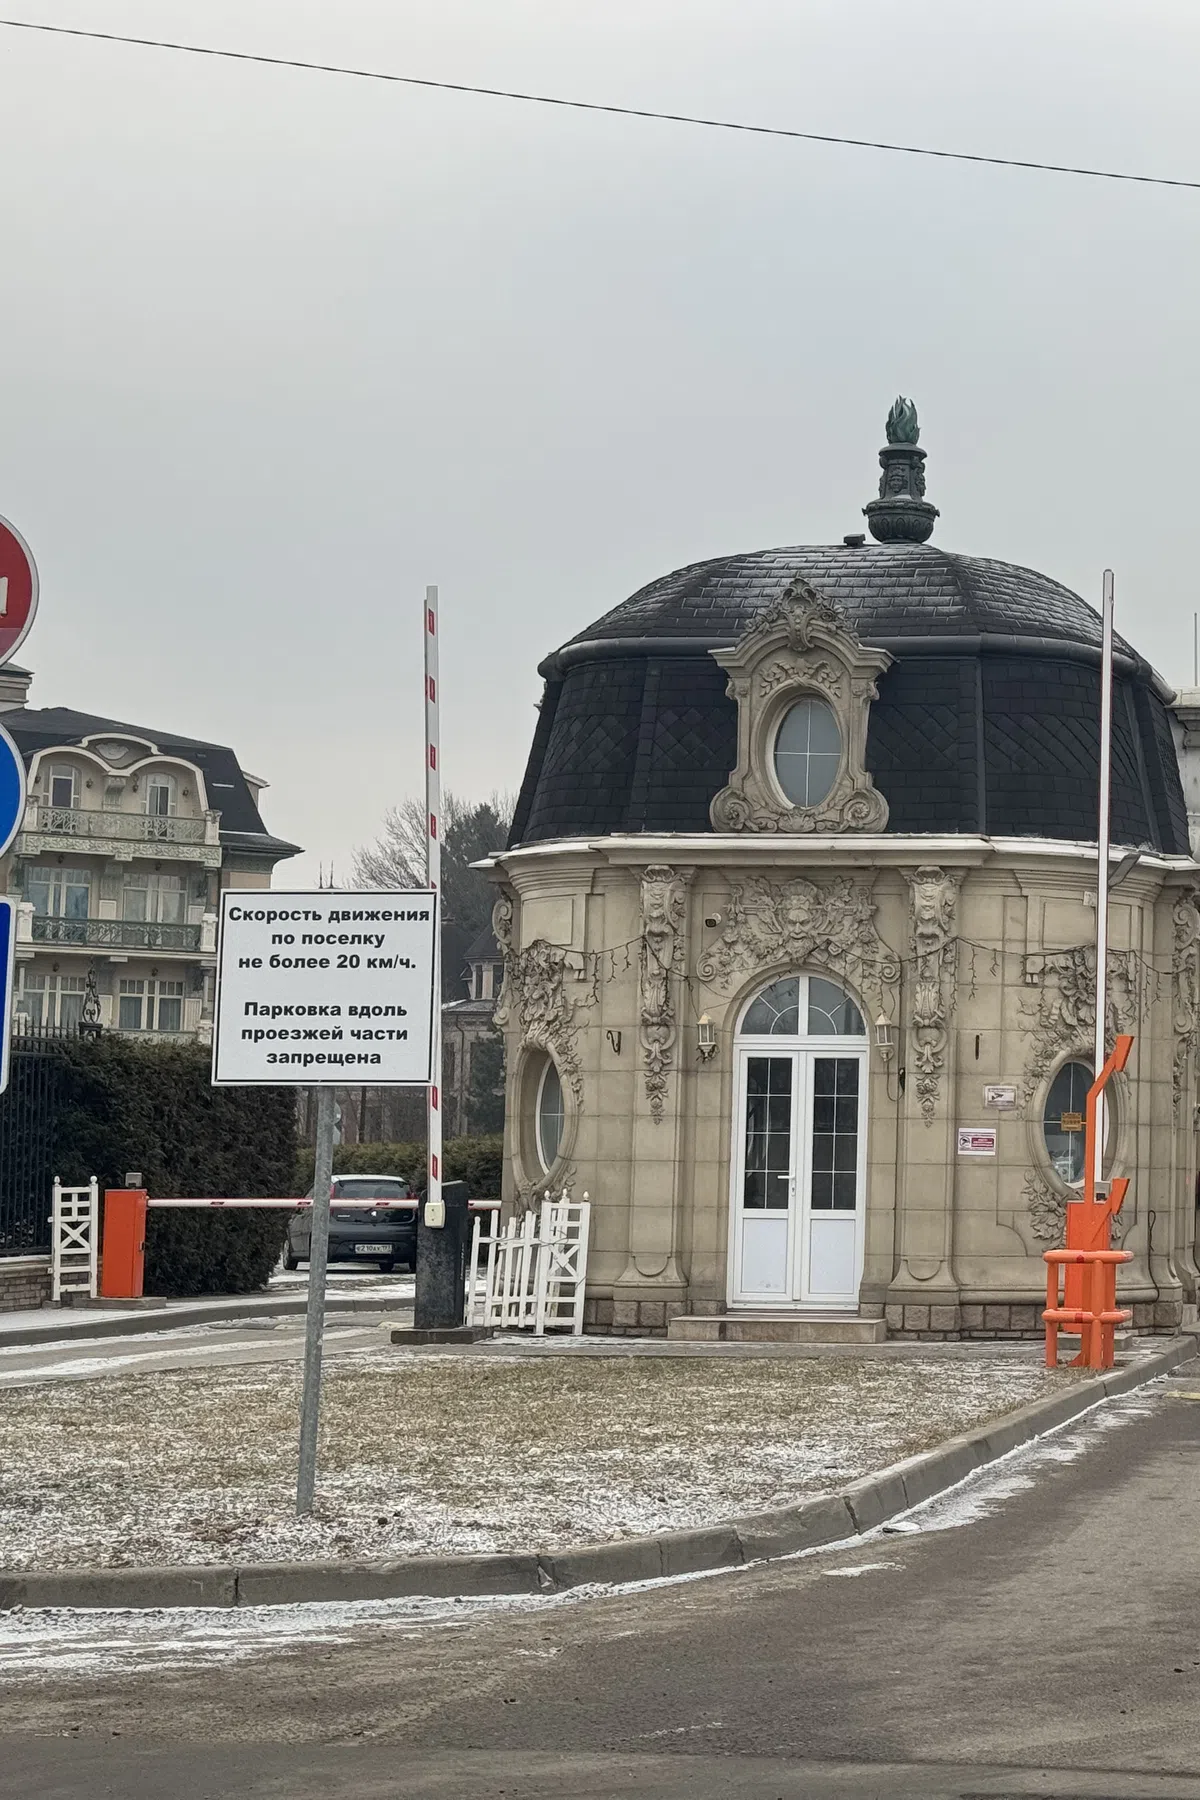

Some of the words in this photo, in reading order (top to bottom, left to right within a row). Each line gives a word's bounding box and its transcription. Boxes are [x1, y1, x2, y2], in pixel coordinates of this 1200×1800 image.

[229, 907, 322, 924] Скорость
[328, 910, 430, 924] движения
[271, 934, 295, 945] по
[301, 934, 386, 949] поселку
[238, 957, 263, 969] не
[269, 954, 331, 969] более
[336, 954, 361, 969] 20
[366, 954, 417, 969] км/ч.
[244, 1002, 342, 1019] Парковка
[348, 1006, 408, 1020] вдоль
[241, 1026, 344, 1043] проезжей
[350, 1029, 408, 1041] части
[266, 1052, 382, 1067] запрещена
